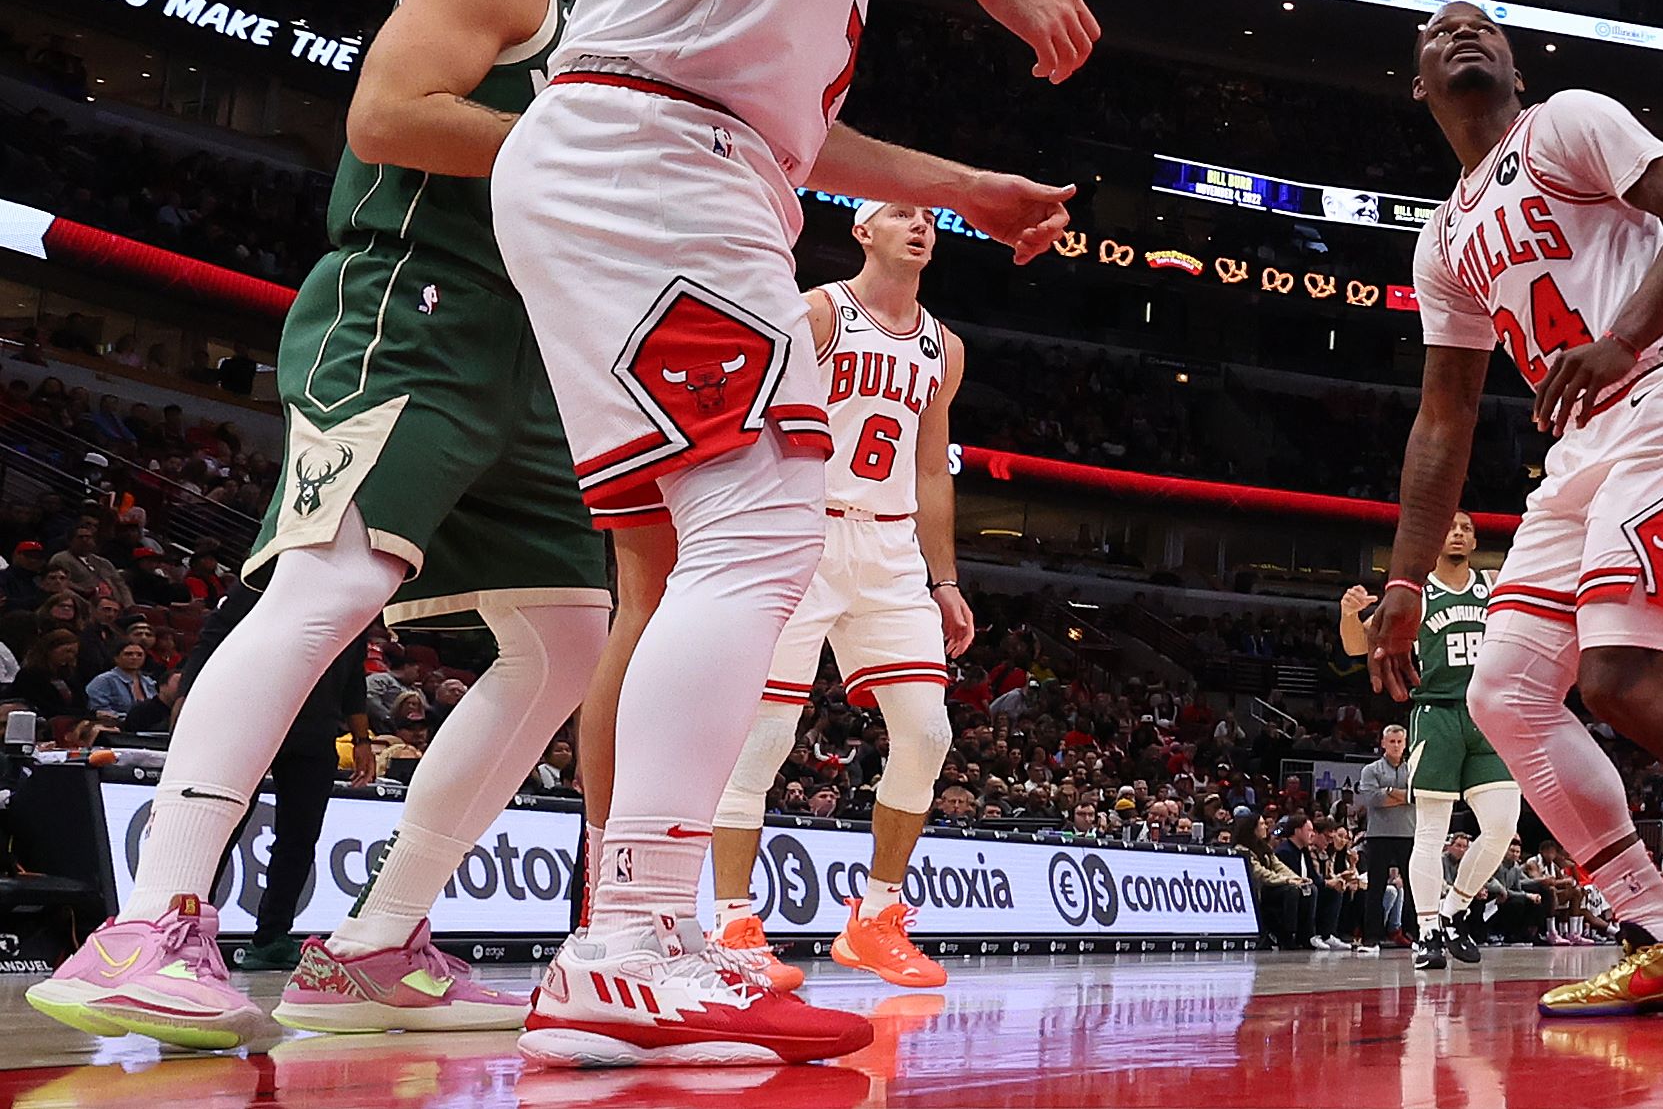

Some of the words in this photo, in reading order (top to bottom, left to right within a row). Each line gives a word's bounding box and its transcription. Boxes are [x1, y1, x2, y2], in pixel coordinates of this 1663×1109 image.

[288, 27, 361, 72] THE
[1195, 182, 1234, 199] NOVEMBER
[1207, 170, 1226, 186] BILL
[1228, 174, 1252, 191] BURR
[1394, 205, 1412, 216] BILL
[1492, 272, 1595, 385] 24
[850, 413, 902, 482] 6
[1425, 605, 1488, 634] MILWAUK
[1446, 632, 1483, 667] 28
[330, 833, 577, 901] cootox
[827, 853, 1014, 910] cootoxia
[1122, 867, 1246, 913] conotoxia
[0, 960, 53, 972] ANDUEL
